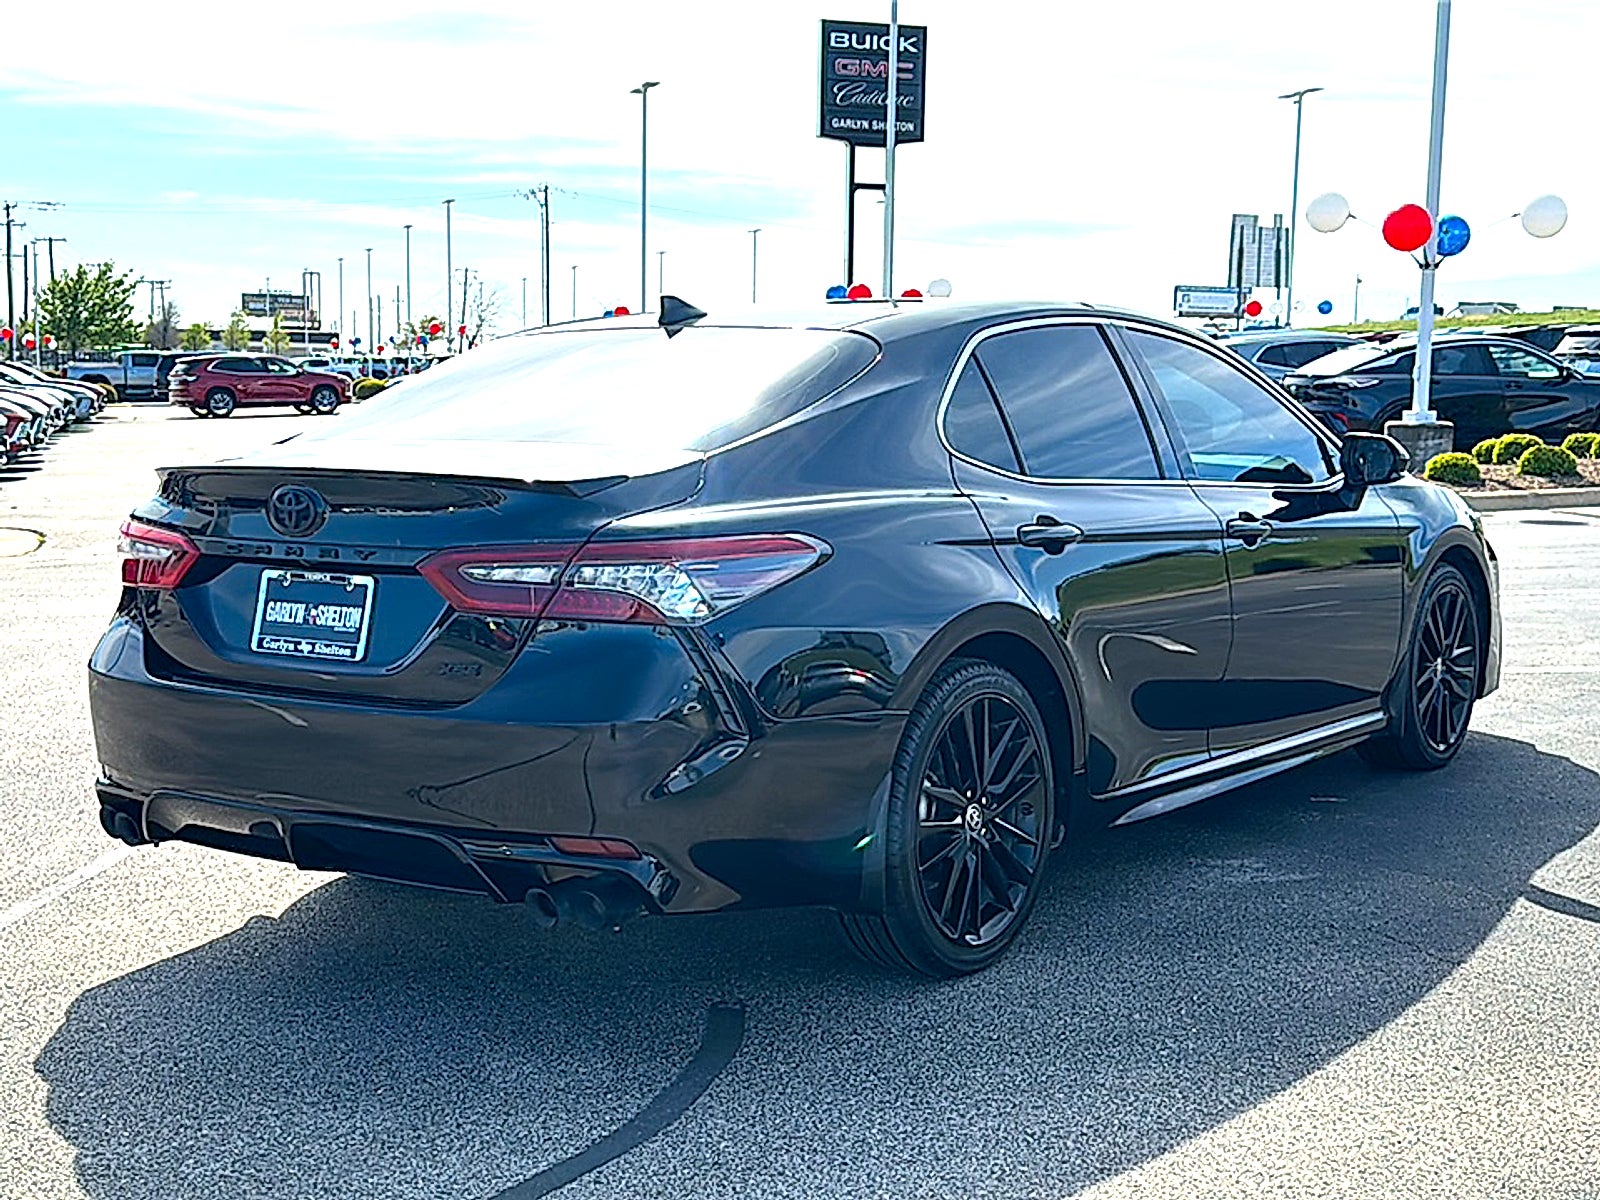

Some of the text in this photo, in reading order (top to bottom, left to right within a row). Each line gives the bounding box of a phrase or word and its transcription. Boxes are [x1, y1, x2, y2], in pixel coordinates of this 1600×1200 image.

[830, 31, 919, 53] BUICK
[834, 57, 914, 79] GMC
[831, 117, 915, 132] GARLYN SHTON
[265, 601, 363, 628] GARLYN SHELTON
